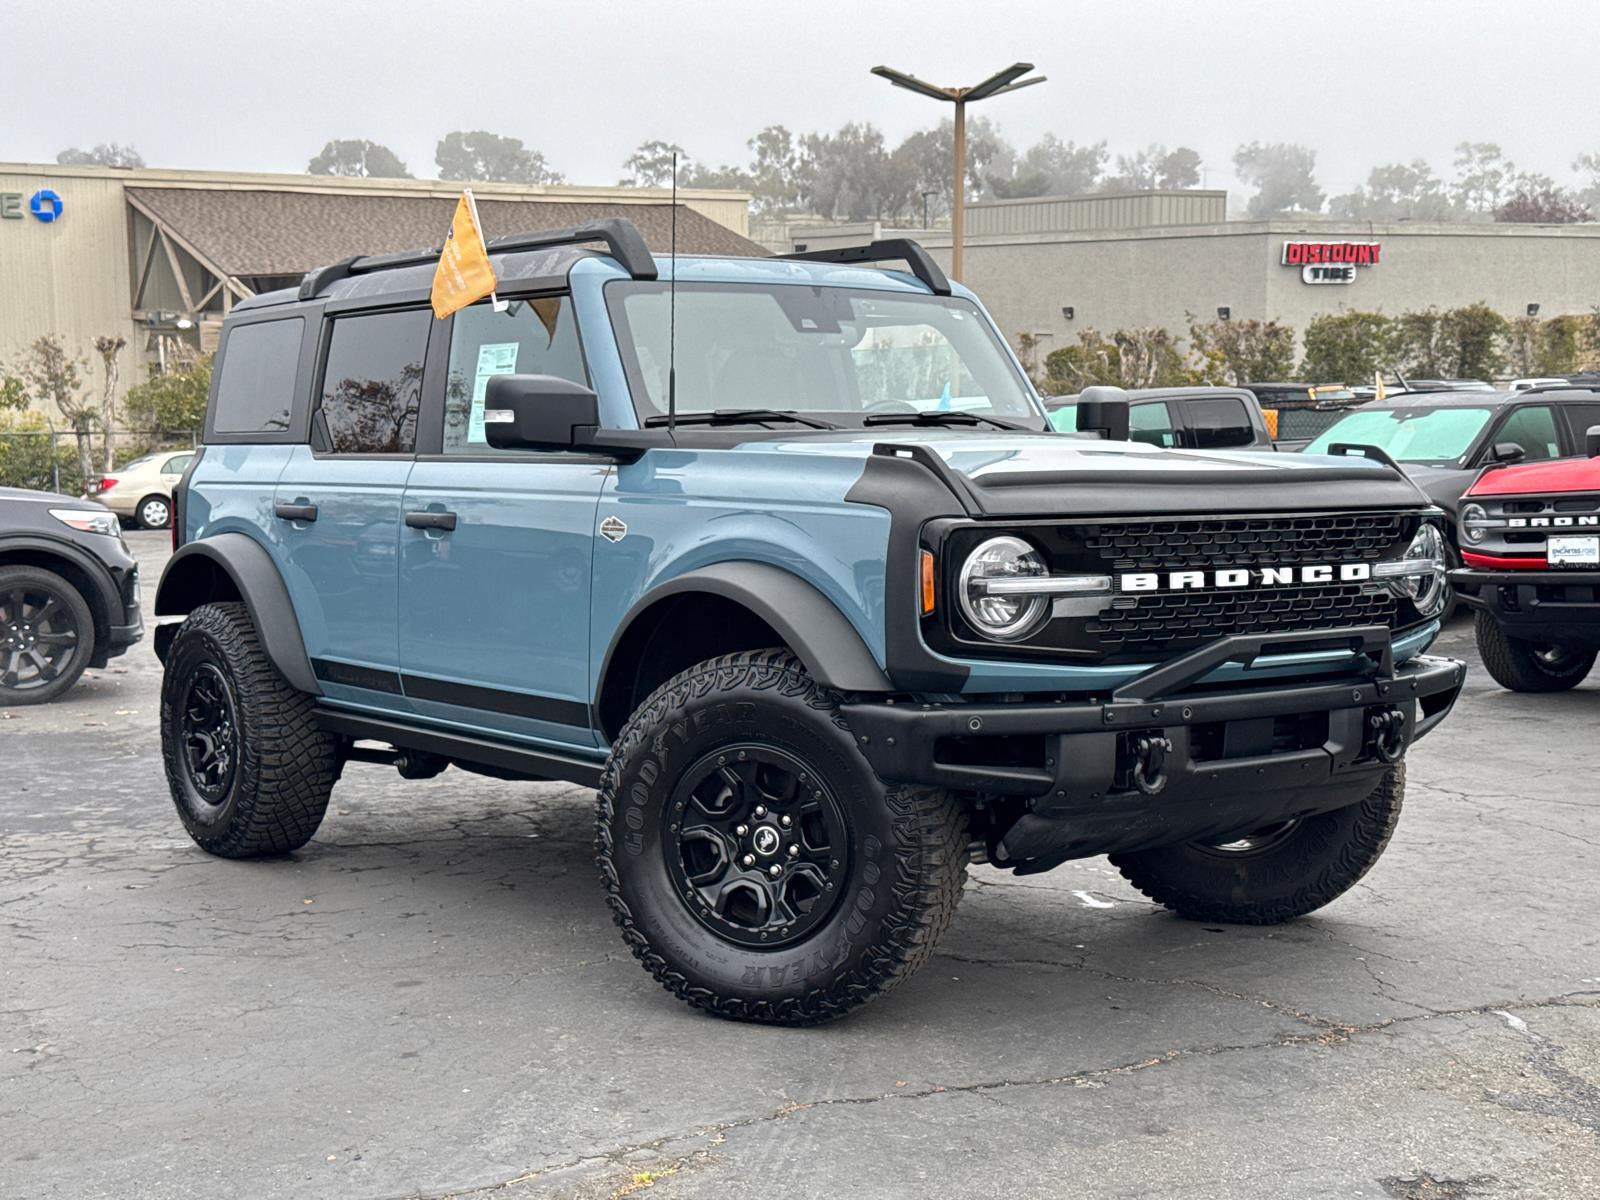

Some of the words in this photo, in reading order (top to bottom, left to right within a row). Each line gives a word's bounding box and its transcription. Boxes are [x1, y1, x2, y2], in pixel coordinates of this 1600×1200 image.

[0, 193, 24, 219] E
[1285, 242, 1381, 264] DISCOUNT
[1311, 267, 1353, 280] TIRE
[1508, 516, 1599, 528] BRON
[1121, 563, 1370, 591] BRONCO
